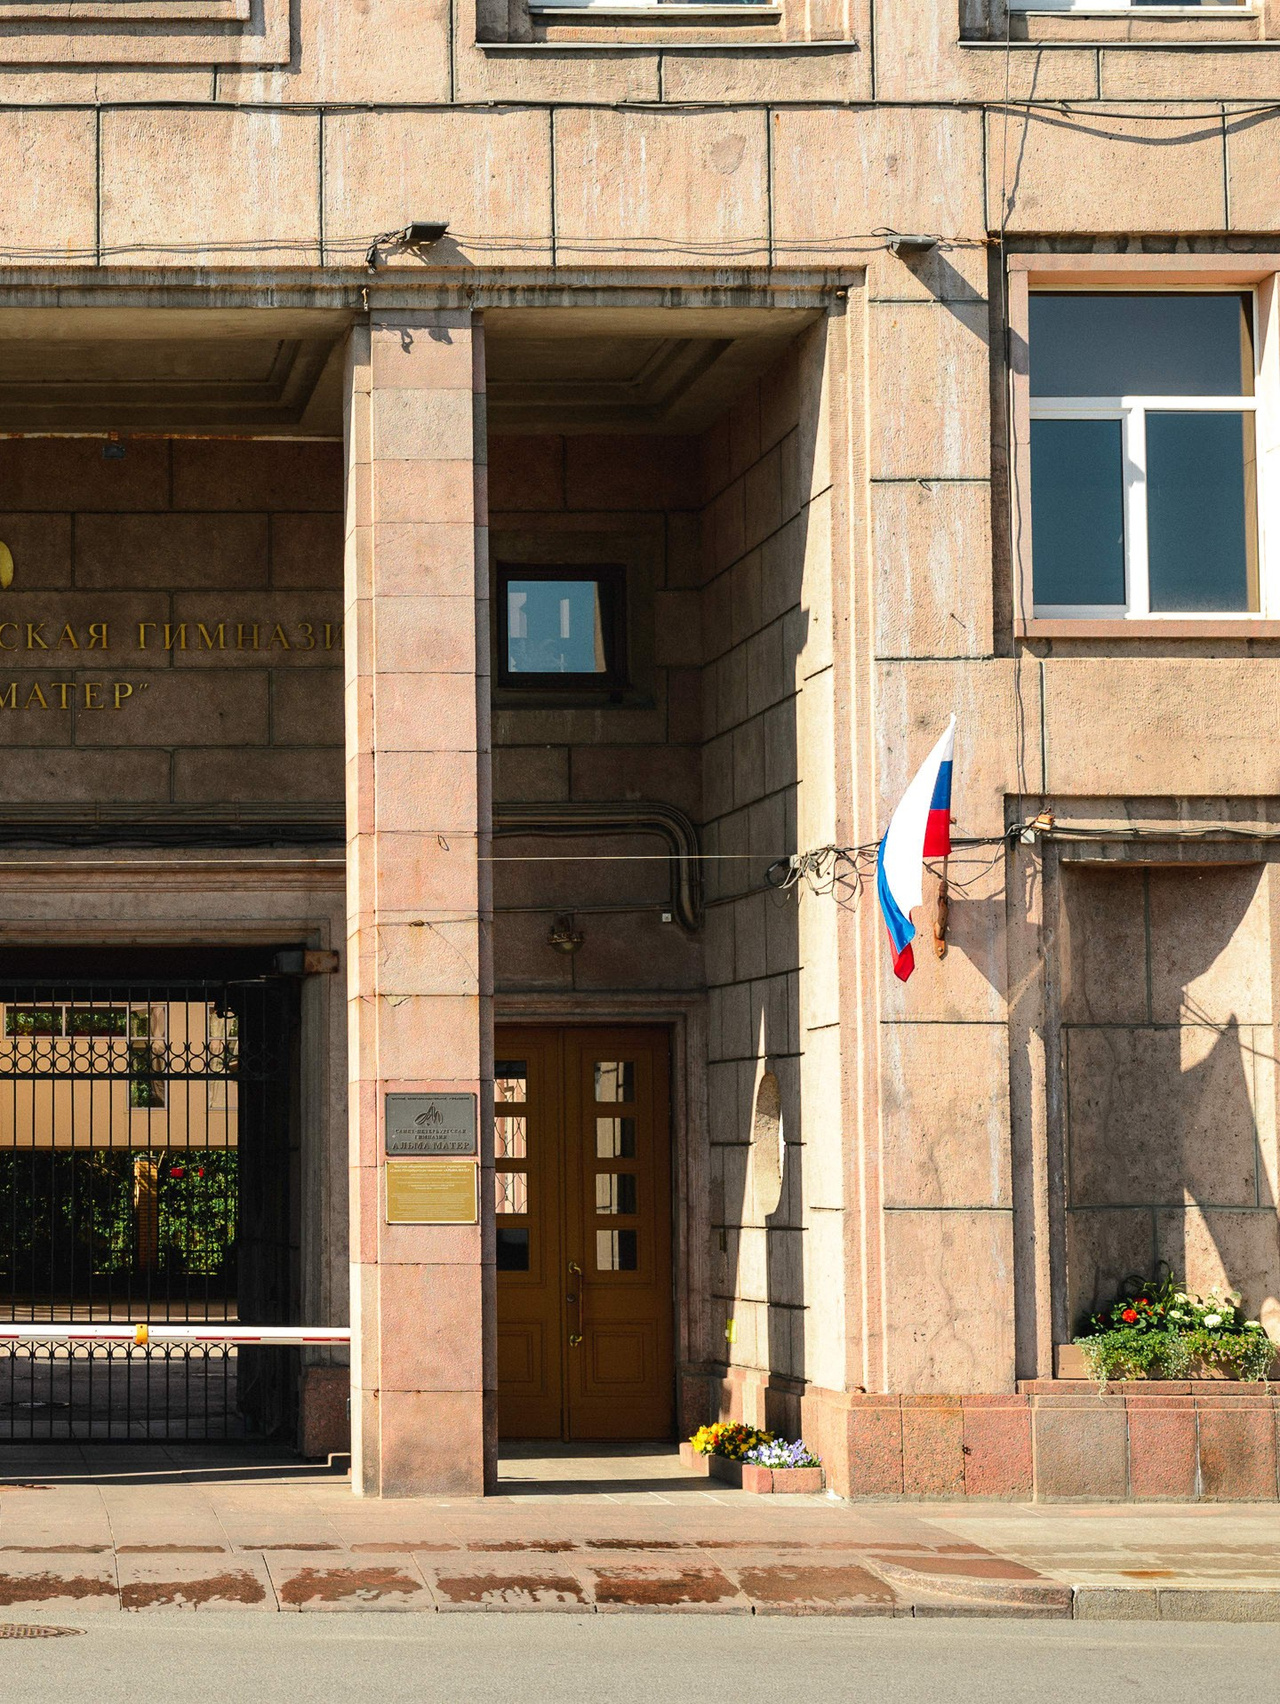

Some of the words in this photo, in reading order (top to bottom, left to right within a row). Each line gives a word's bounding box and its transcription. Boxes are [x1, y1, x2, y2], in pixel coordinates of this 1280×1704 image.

[138, 621, 345, 650] ГИМНАЗИ
[392, 1141, 430, 1150] АЛЬМА
[433, 1141, 470, 1150] МАТЕР
